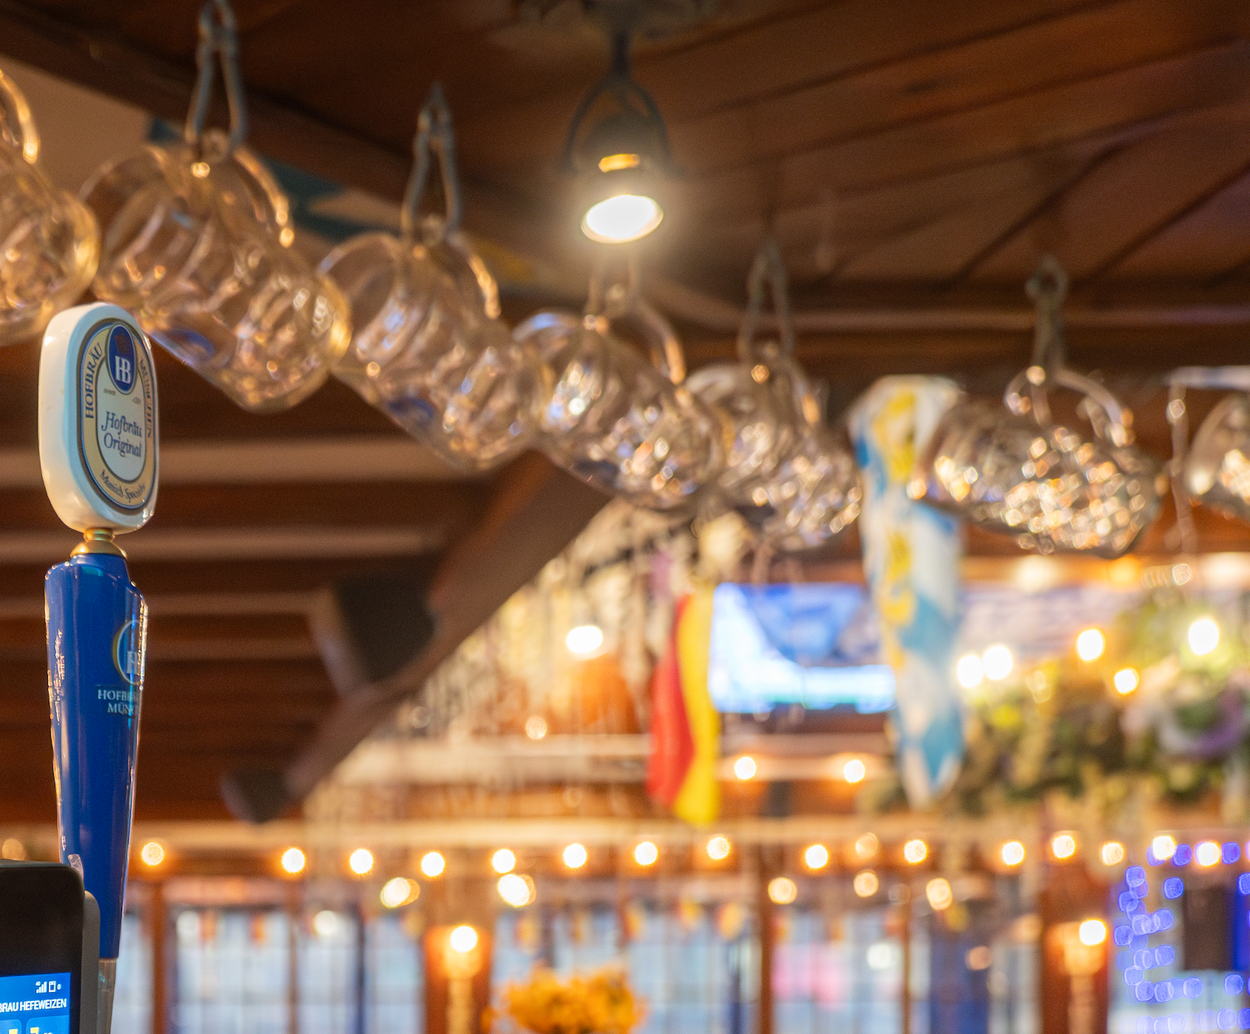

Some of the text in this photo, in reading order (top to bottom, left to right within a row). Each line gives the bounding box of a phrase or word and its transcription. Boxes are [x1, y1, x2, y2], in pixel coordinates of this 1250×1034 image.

[85, 342, 103, 419] HOFBRÄU
[114, 355, 131, 385] HB
[101, 410, 142, 438] Hofbräu
[103, 433, 142, 458] Original
[19, 998, 67, 1012] HEFEWEIZEN
